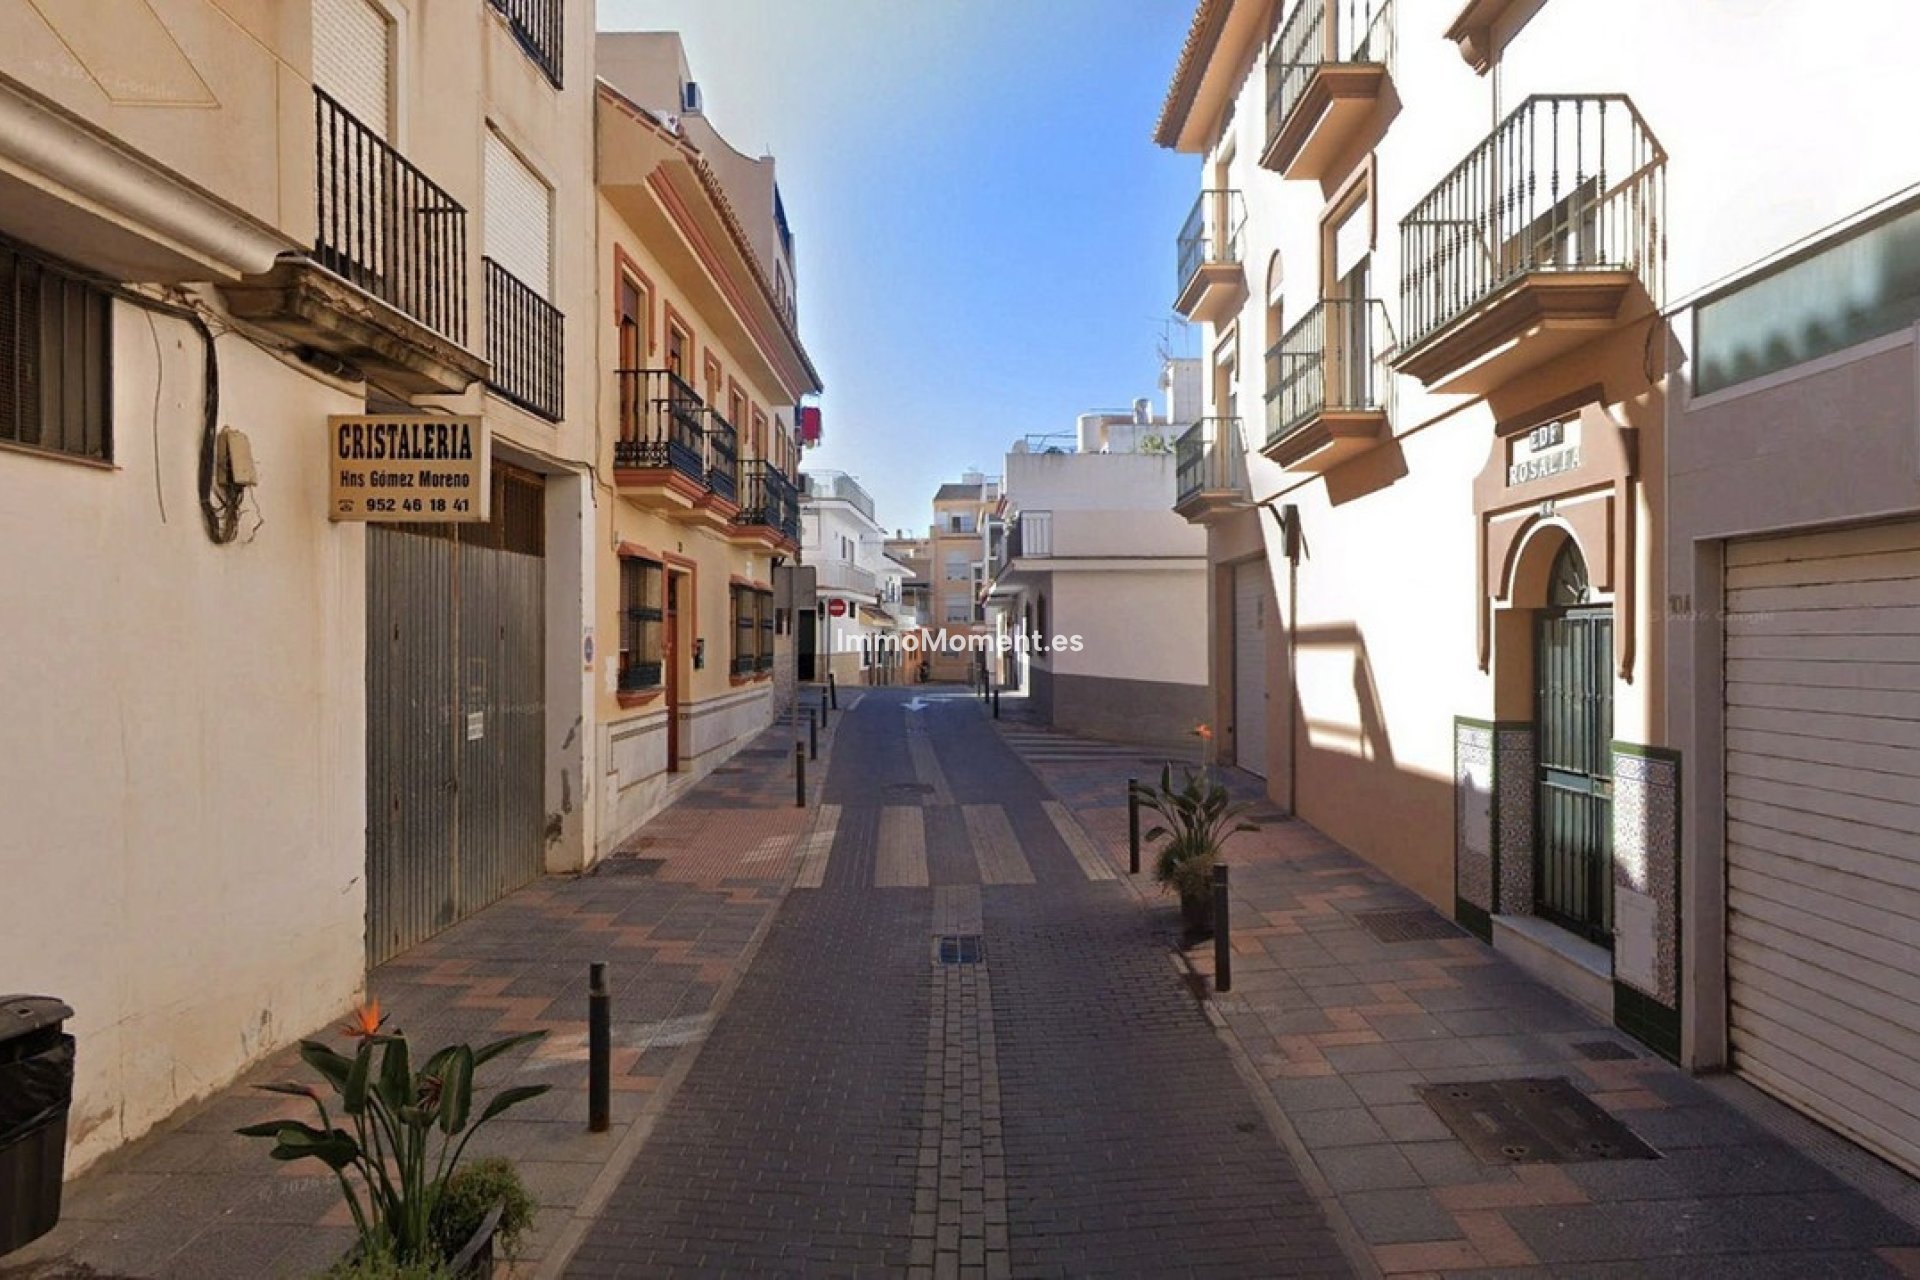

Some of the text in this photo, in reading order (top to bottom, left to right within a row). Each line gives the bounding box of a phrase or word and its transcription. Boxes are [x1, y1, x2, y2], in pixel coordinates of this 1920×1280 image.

[338, 423, 472, 460] CRISTALERIA
[340, 470, 470, 487] Hns Gómez Moreno
[366, 498, 469, 512] 952 46 18 41
